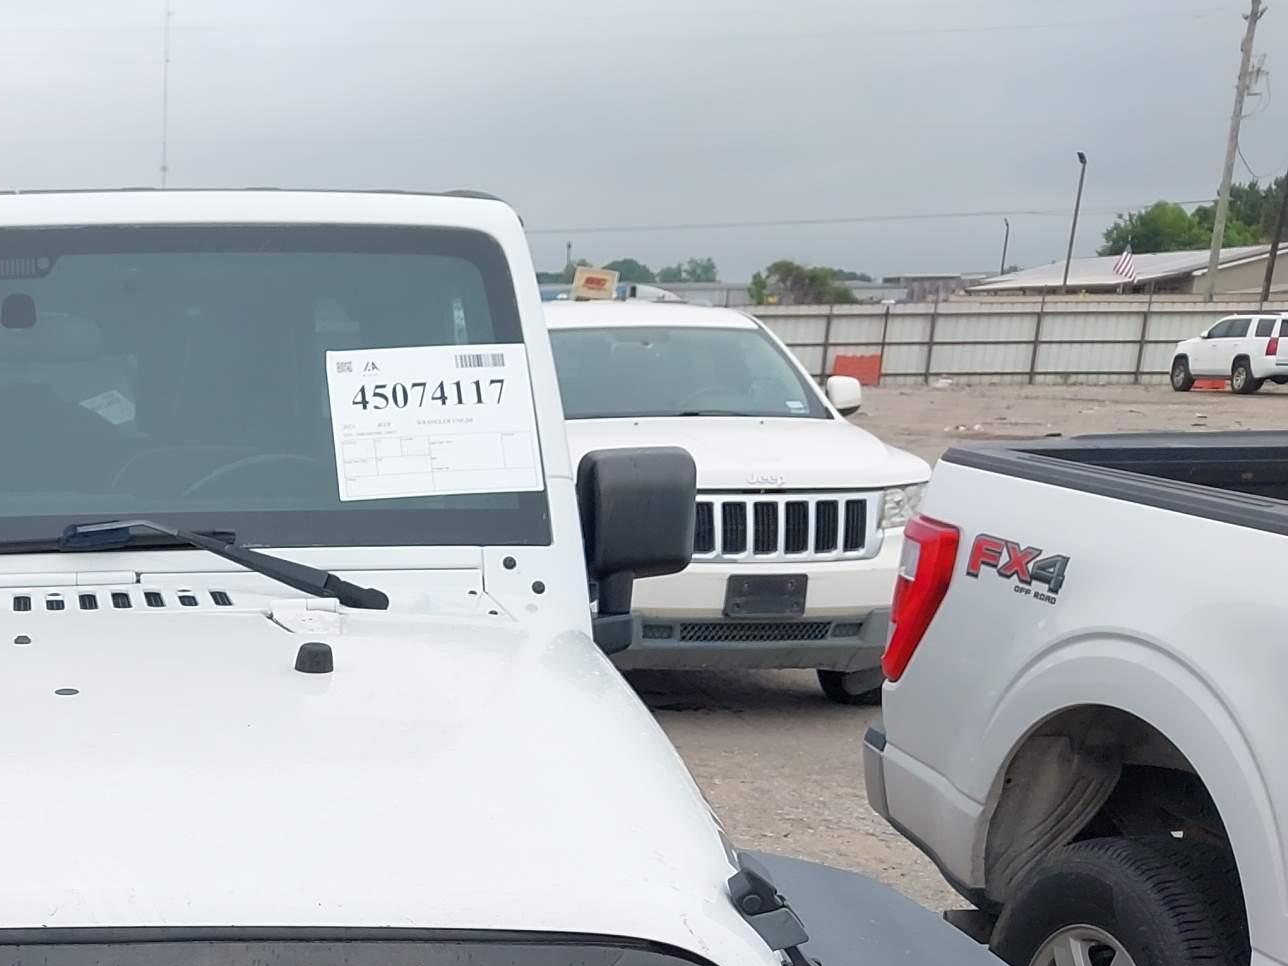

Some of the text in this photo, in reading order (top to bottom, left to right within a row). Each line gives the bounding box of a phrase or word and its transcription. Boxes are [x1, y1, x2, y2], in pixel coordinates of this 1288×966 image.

[352, 379, 505, 410] 45074117
[746, 471, 785, 486] Jeep
[966, 533, 1070, 595] FX4
[1014, 585, 1057, 605] OFF ROAD
